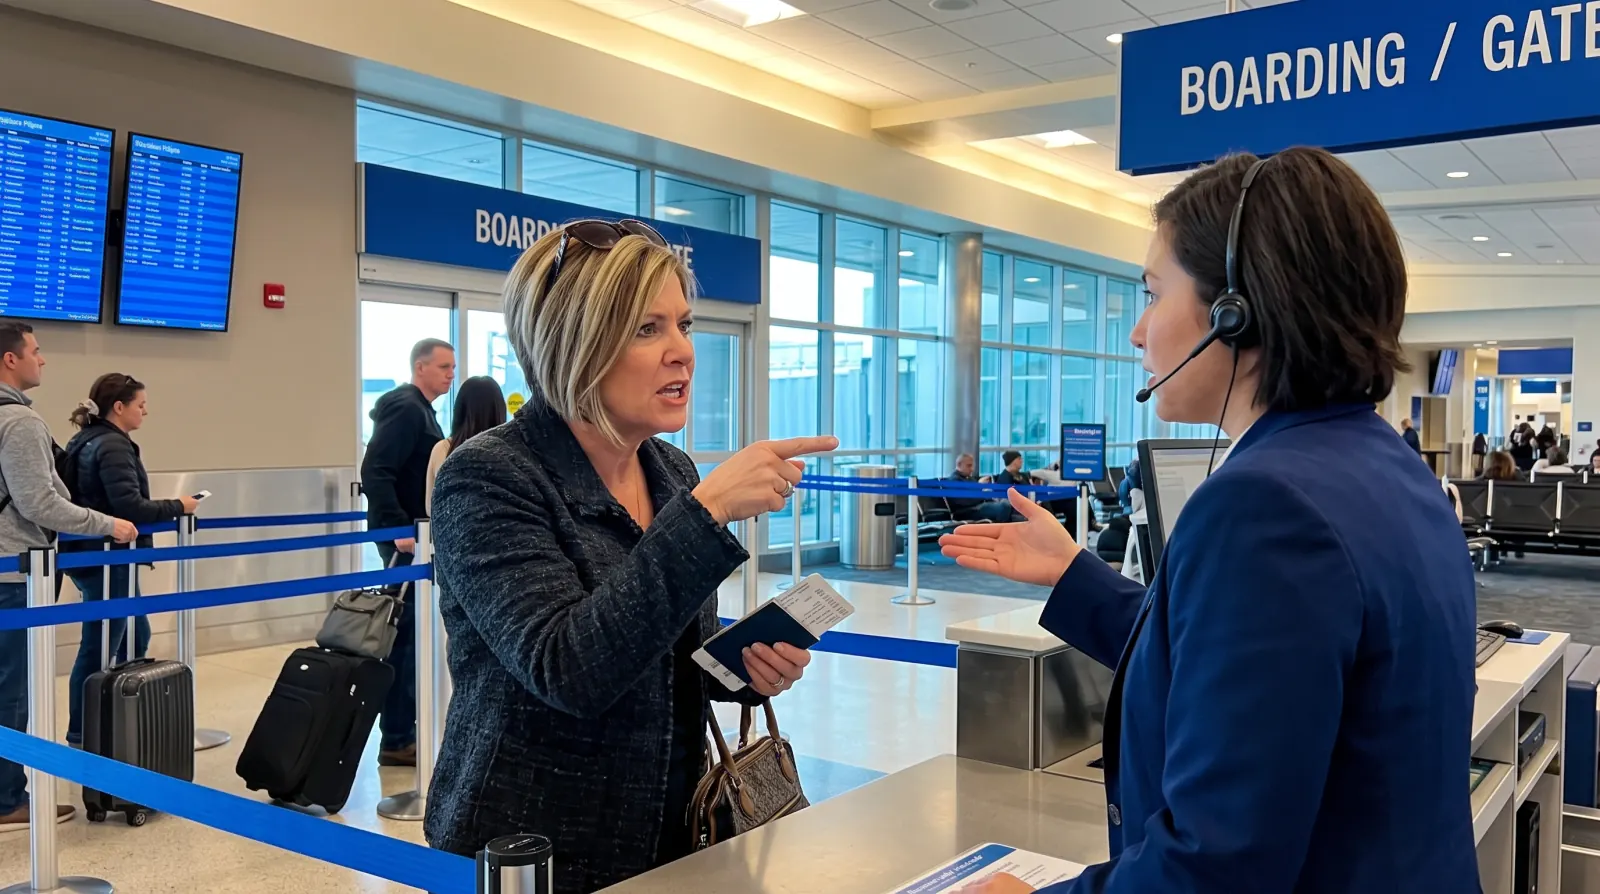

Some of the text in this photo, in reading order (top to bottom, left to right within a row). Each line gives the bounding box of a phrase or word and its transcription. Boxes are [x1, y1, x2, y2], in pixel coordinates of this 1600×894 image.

[1180, 0, 1600, 116] BOARDING / GATE
[476, 209, 694, 274] BOARD TE
